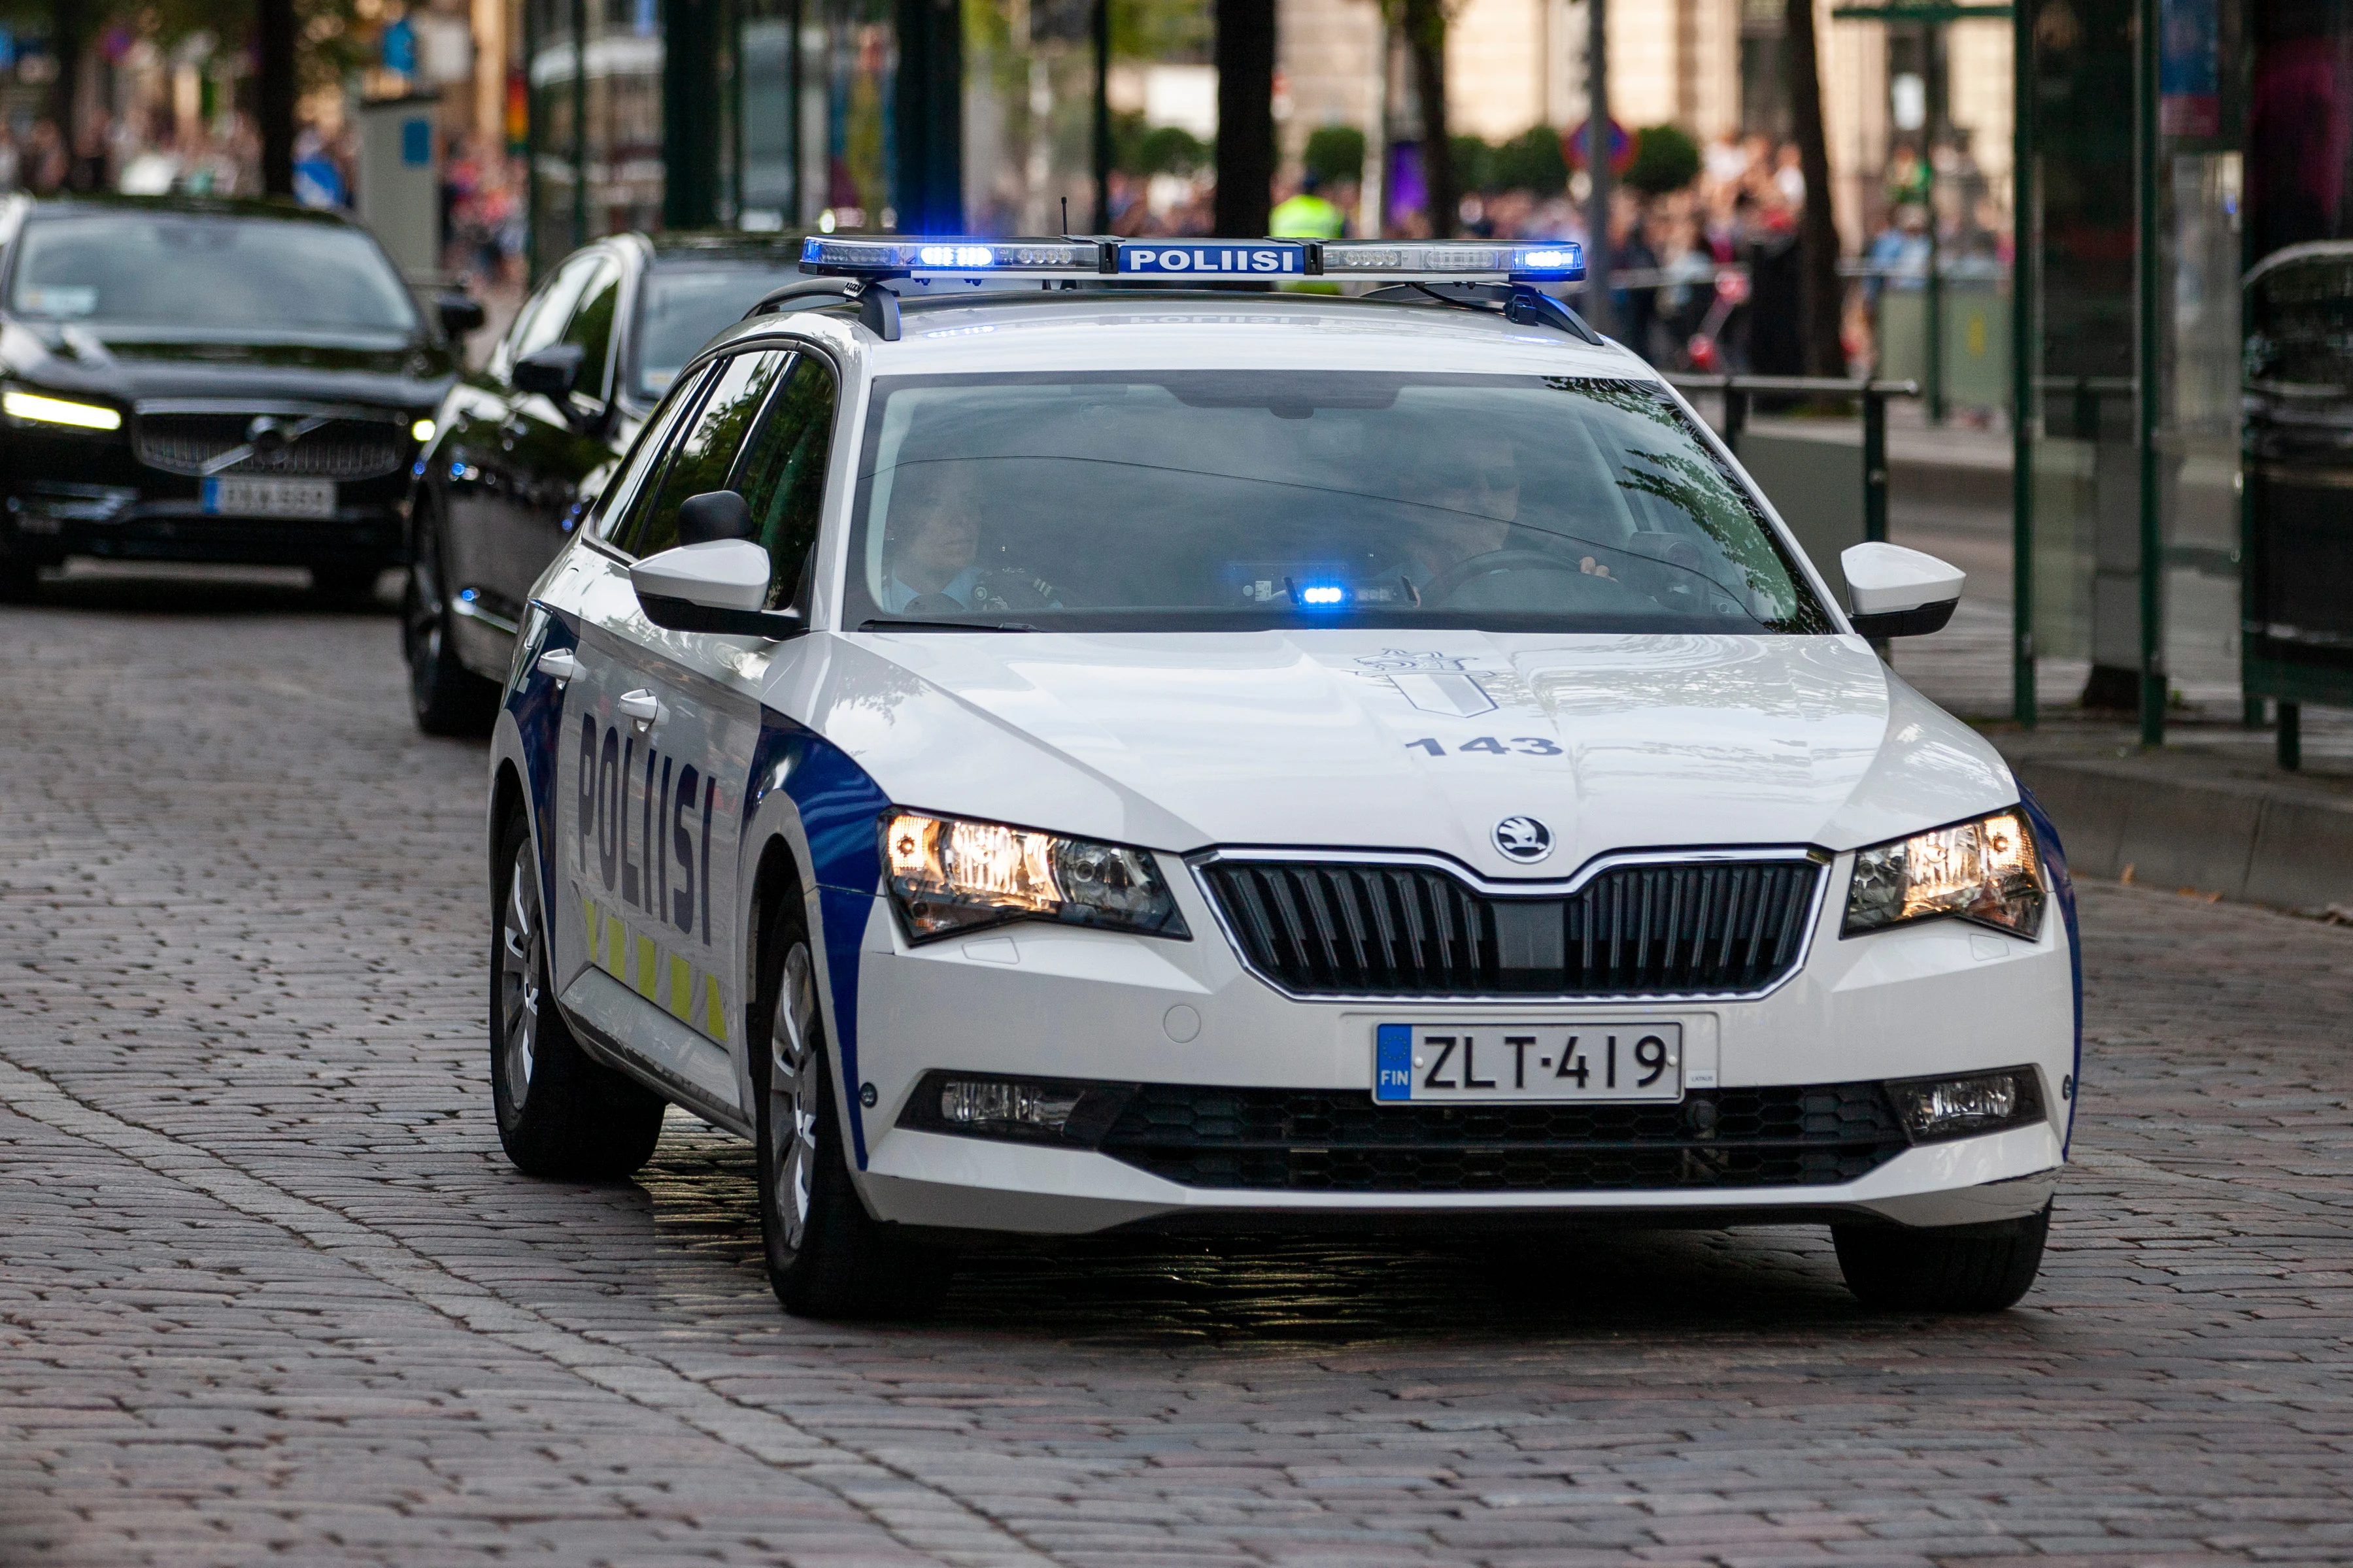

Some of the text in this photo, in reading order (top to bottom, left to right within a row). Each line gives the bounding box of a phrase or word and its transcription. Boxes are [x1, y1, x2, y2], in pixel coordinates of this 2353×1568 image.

[1130, 250, 1293, 271] POLIISI
[1404, 737, 1565, 757] 143
[578, 712, 716, 946] POLIISI
[1380, 1069, 1409, 1086] FIN
